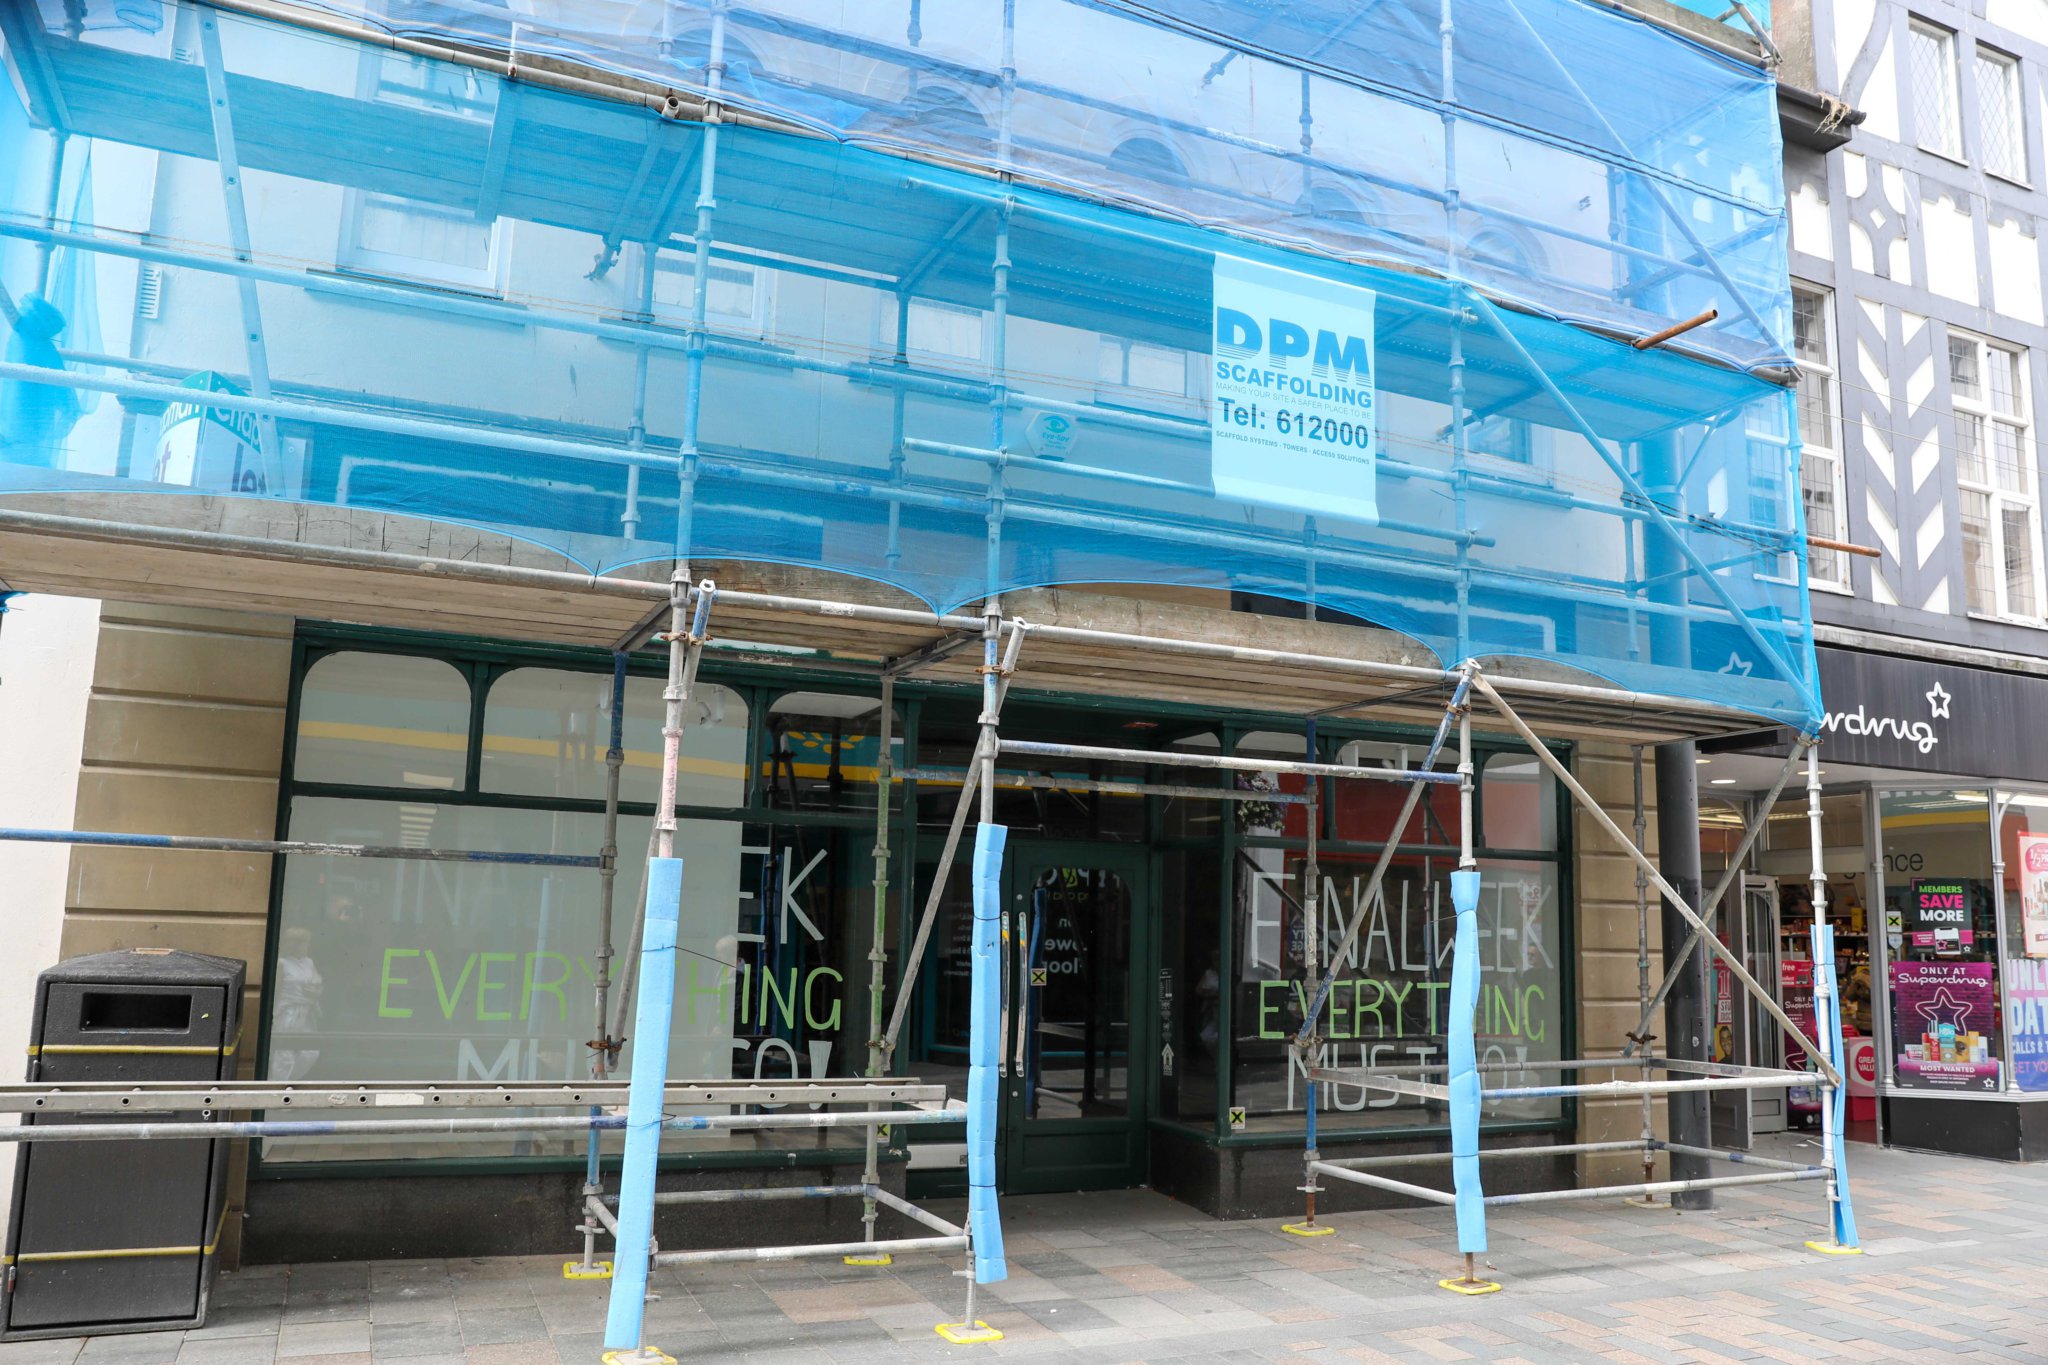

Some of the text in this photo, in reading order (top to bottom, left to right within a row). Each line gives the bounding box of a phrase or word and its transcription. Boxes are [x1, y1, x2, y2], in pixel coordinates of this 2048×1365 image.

[1217, 306, 1372, 388] DPM
[1216, 361, 1372, 408] SCAFFOLDING
[1216, 382, 1247, 394] MAKING
[1249, 389, 1270, 399] YOUR
[1273, 393, 1290, 403] SITE
[1298, 399, 1322, 409] SAFER
[1325, 404, 1348, 415] PLACE
[1217, 396, 1369, 449] Tel: 612000
[1216, 430, 1370, 465] SCAFFOLD SYSTEMS TOWERS ACCESS SOLUTIONS
[1919, 885, 1963, 894] MEMBERS
[1919, 894, 1964, 909] SAVE
[1919, 909, 1964, 922] MORE
[1898, 973, 1988, 987] Superdrug
[1919, 966, 1966, 975] ONLY AT
